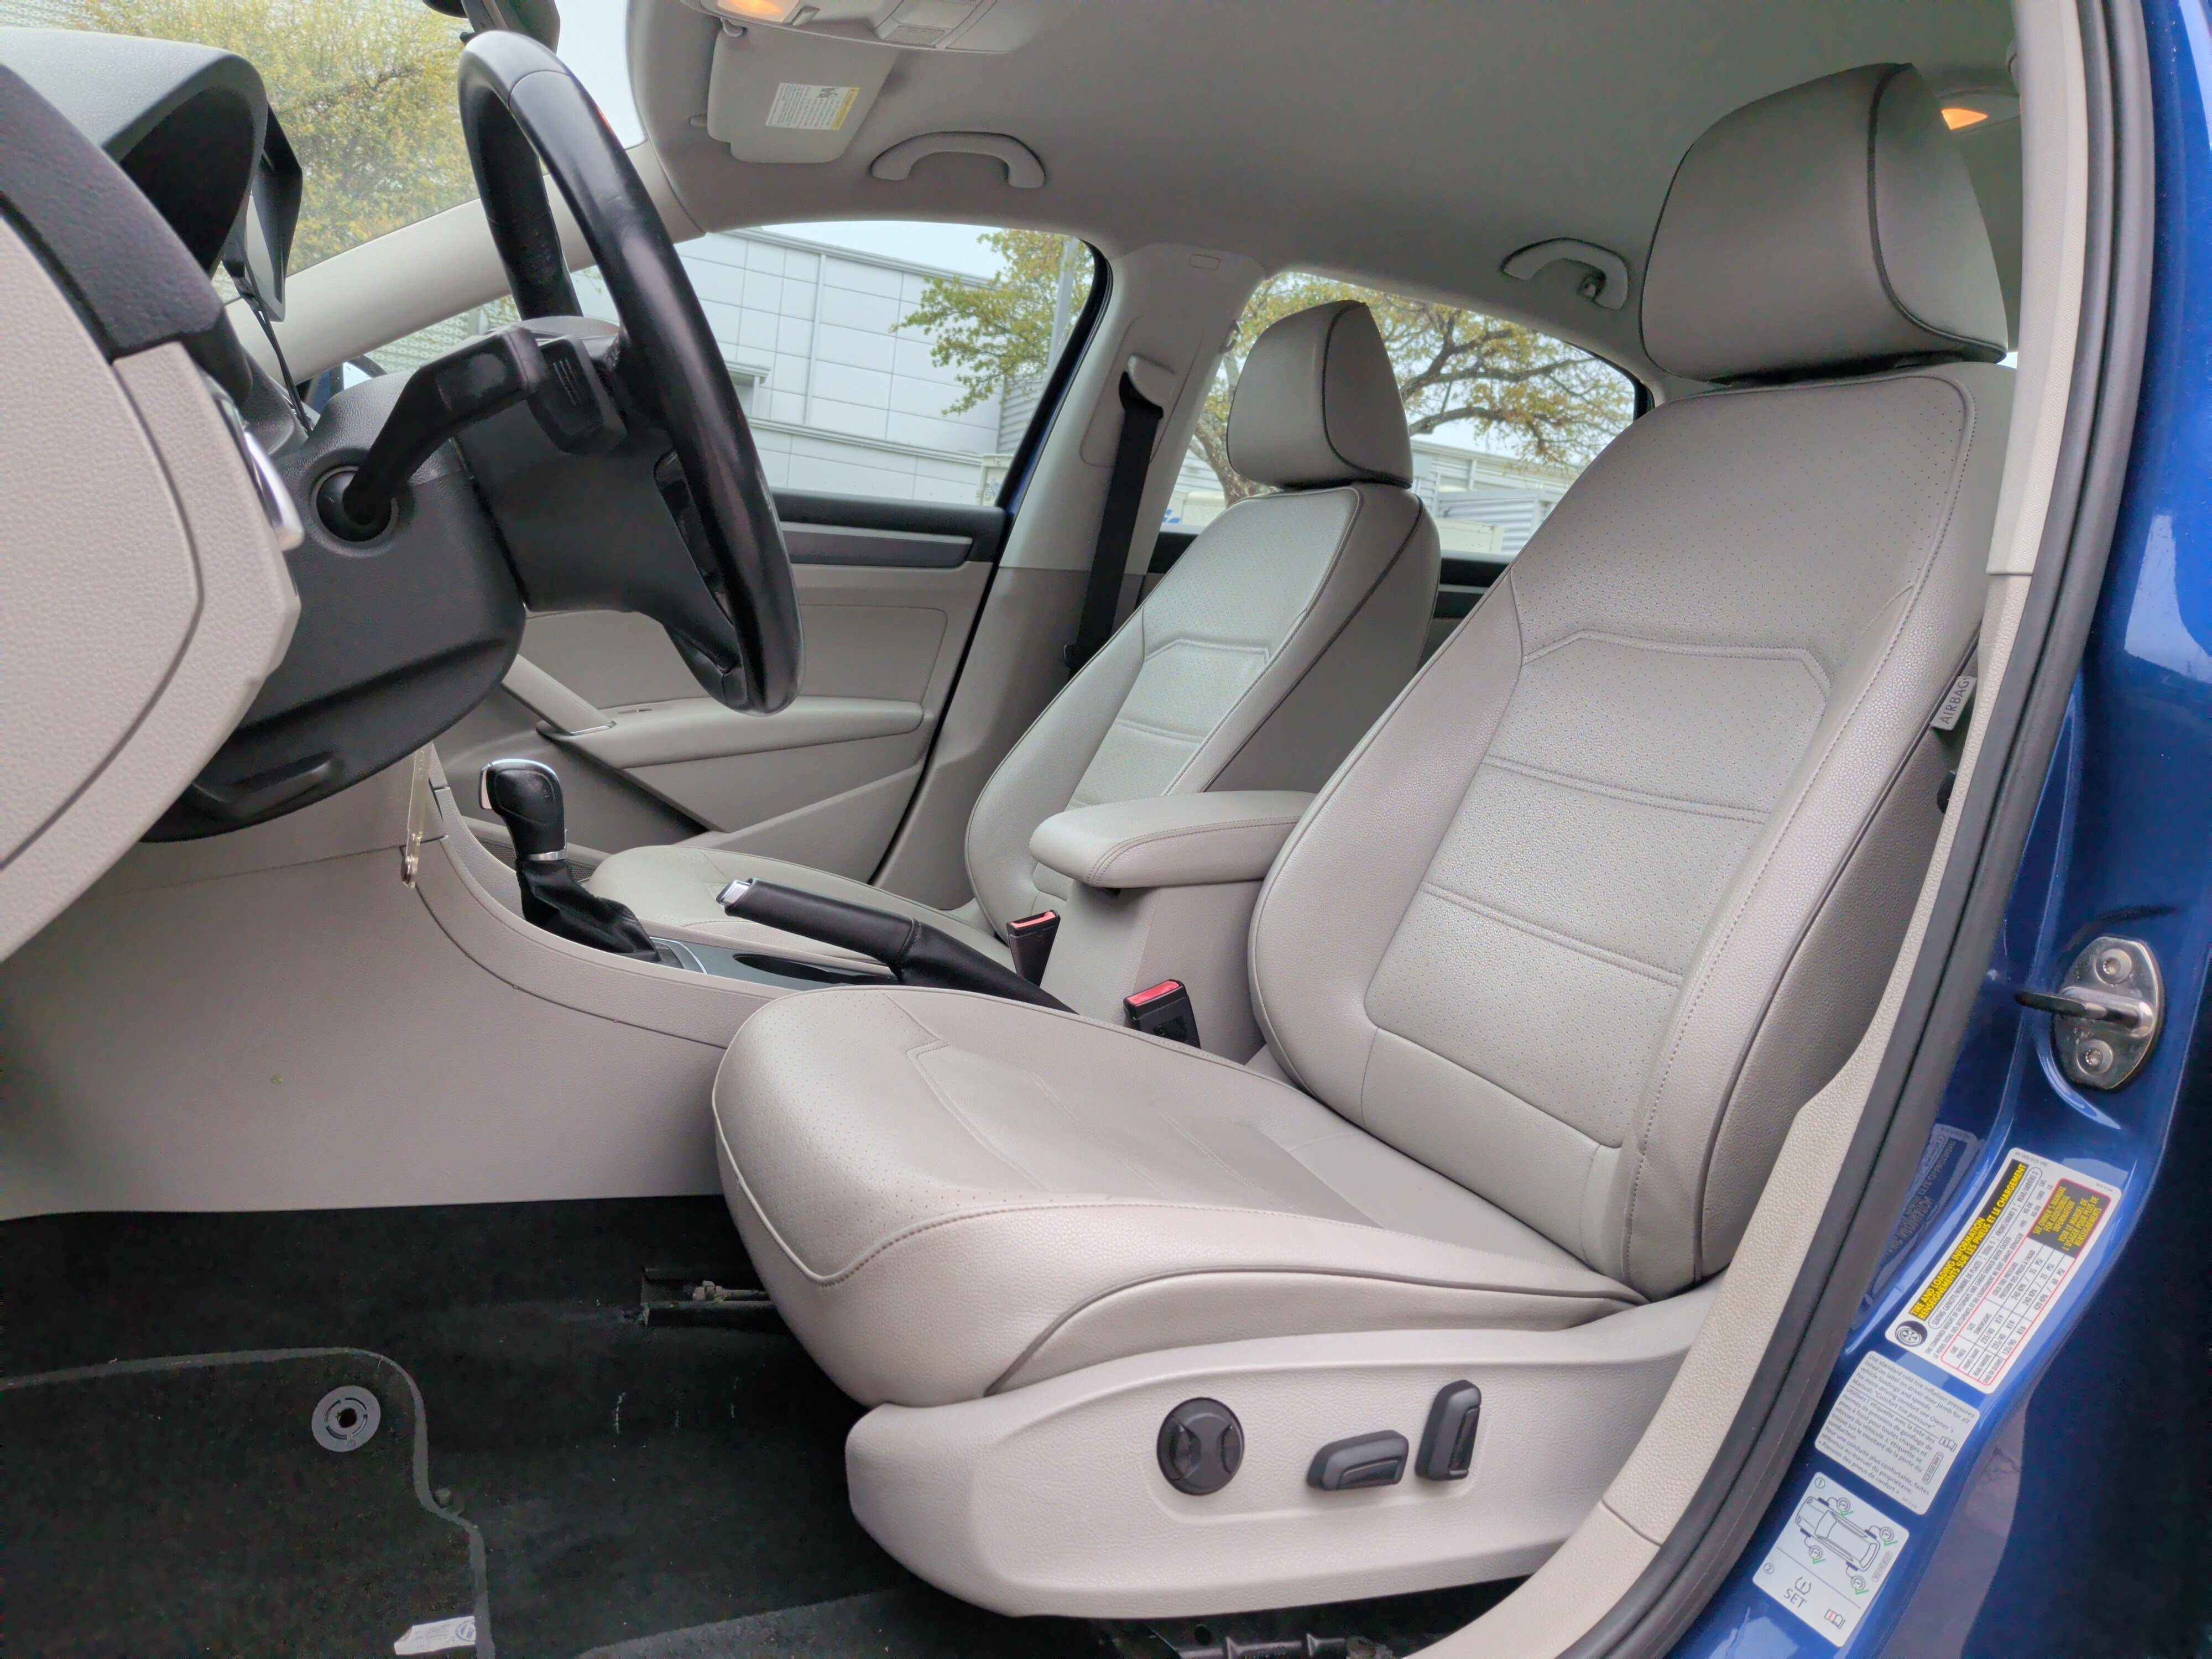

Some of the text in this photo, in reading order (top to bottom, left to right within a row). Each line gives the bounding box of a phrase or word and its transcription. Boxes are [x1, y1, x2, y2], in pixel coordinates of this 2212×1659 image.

[1940, 678, 1970, 724] AIRBAG
[1994, 1211, 2015, 1237] FRONT/AVANT
[2032, 1224, 2043, 1235] SEE
[2050, 1185, 2067, 1206] MANUAL
[2043, 1194, 2070, 1232] FOR ADDITIONAL
[2052, 1200, 2075, 1232] INFORMATION
[2057, 1229, 2070, 1243] VOIR
[2068, 1205, 2084, 1225] MANUEL
[2079, 1197, 2089, 1206] DE
[2062, 1196, 2099, 1250] L'USAGER POUR PLUS DE
[2074, 1206, 2102, 1246] RENSEIGNEMENTS
[1917, 1163, 2027, 1319] RENSEIGNEMENTS SUR LES PNEUS ET LE CHARGEMENT
[1981, 1244, 1992, 1256] TOTAL
[1910, 1217, 1985, 1316] TIRE AND LOADING INFORMATION
[1991, 1261, 2018, 1296] COLD TIRE PRESSURE
[1999, 1249, 2036, 1299] PRESSION DES PNEUS FROID
[2011, 1291, 2021, 1300] 240
[2017, 1282, 2026, 1292] KPA
[2034, 1258, 2043, 1266] PSI
[2022, 1296, 2032, 1306] 240
[2028, 1288, 2038, 1297] KPA
[2045, 1262, 2054, 1271] PSI
[1931, 1310, 1946, 1326] SEATING
[1942, 1277, 1969, 1311] CAPACITY/NOMBRE
[1969, 1259, 1982, 1274] PLACES
[2033, 1301, 2043, 1311] 420
[2038, 1293, 2048, 1302] KPA
[2056, 1267, 2065, 1276] PSI
[1966, 1322, 1976, 1331] SIZE
[1973, 1312, 1992, 1334] DIMENSIONS
[1980, 1314, 2004, 1344] 235/40 R19
[1991, 1319, 2015, 1350] 235/40 R19
[2002, 1325, 2026, 1356] 135/90 R16
[1949, 1345, 1959, 1355] TIRE
[1955, 1348, 1966, 1359] PNEU
[1859, 1366, 1932, 1412] vehicle loadings and speeds.
[1864, 1360, 1879, 1371] listed
[1886, 1373, 1900, 1383] label
[1907, 1384, 1923, 1397] driver
[1923, 1394, 1937, 1405] door
[1936, 1401, 1953, 1415] jamb
[1952, 1411, 1961, 1419] for
[1864, 1378, 1879, 1388] more
[1877, 1385, 1898, 1400] driving
[1897, 1396, 1919, 1412] comfort
[1919, 1410, 1929, 1418] see
[1868, 1354, 1975, 1419] Use standard cold tire inflation pressures
[1834, 1406, 1855, 1421] vitesses
[1838, 1401, 1851, 1411] pneu
[1856, 1410, 1869, 1421] froid
[1868, 1419, 1881, 1430] pour
[1881, 1426, 1899, 1439] toutes
[1898, 1437, 1921, 1454] charges
[1842, 1394, 1861, 1407] normes
[1868, 1409, 1893, 1428] pressions
[1900, 1428, 1925, 1447] gonflage
[1846, 1387, 1866, 1402] Utilisez
[1894, 1417, 1906, 1426] avec
[1912, 1427, 1925, 1437] liste
[1924, 1434, 1936, 1443] des
[1898, 1406, 1908, 1414] tire
[1821, 1432, 1844, 1450] référence
[1851, 1452, 1872, 1468] manuel
[1824, 1426, 1837, 1436] Pour
[1846, 1439, 1869, 1457] conduite
[1869, 1454, 1881, 1465] plus
[1880, 1462, 1914, 1485] confortable,
[1914, 1482, 1930, 1495] faites
[1831, 1413, 1848, 1426] trouve
[1862, 1432, 1885, 1449] montant
[1898, 1455, 1914, 1468] porte
[1821, 1441, 1843, 1458] Pression
[1842, 1454, 1852, 1464] des
[1851, 1462, 1867, 1475] pneus
[1875, 1476, 1895, 1491] confort
[1783, 1587, 1807, 1610] SET
